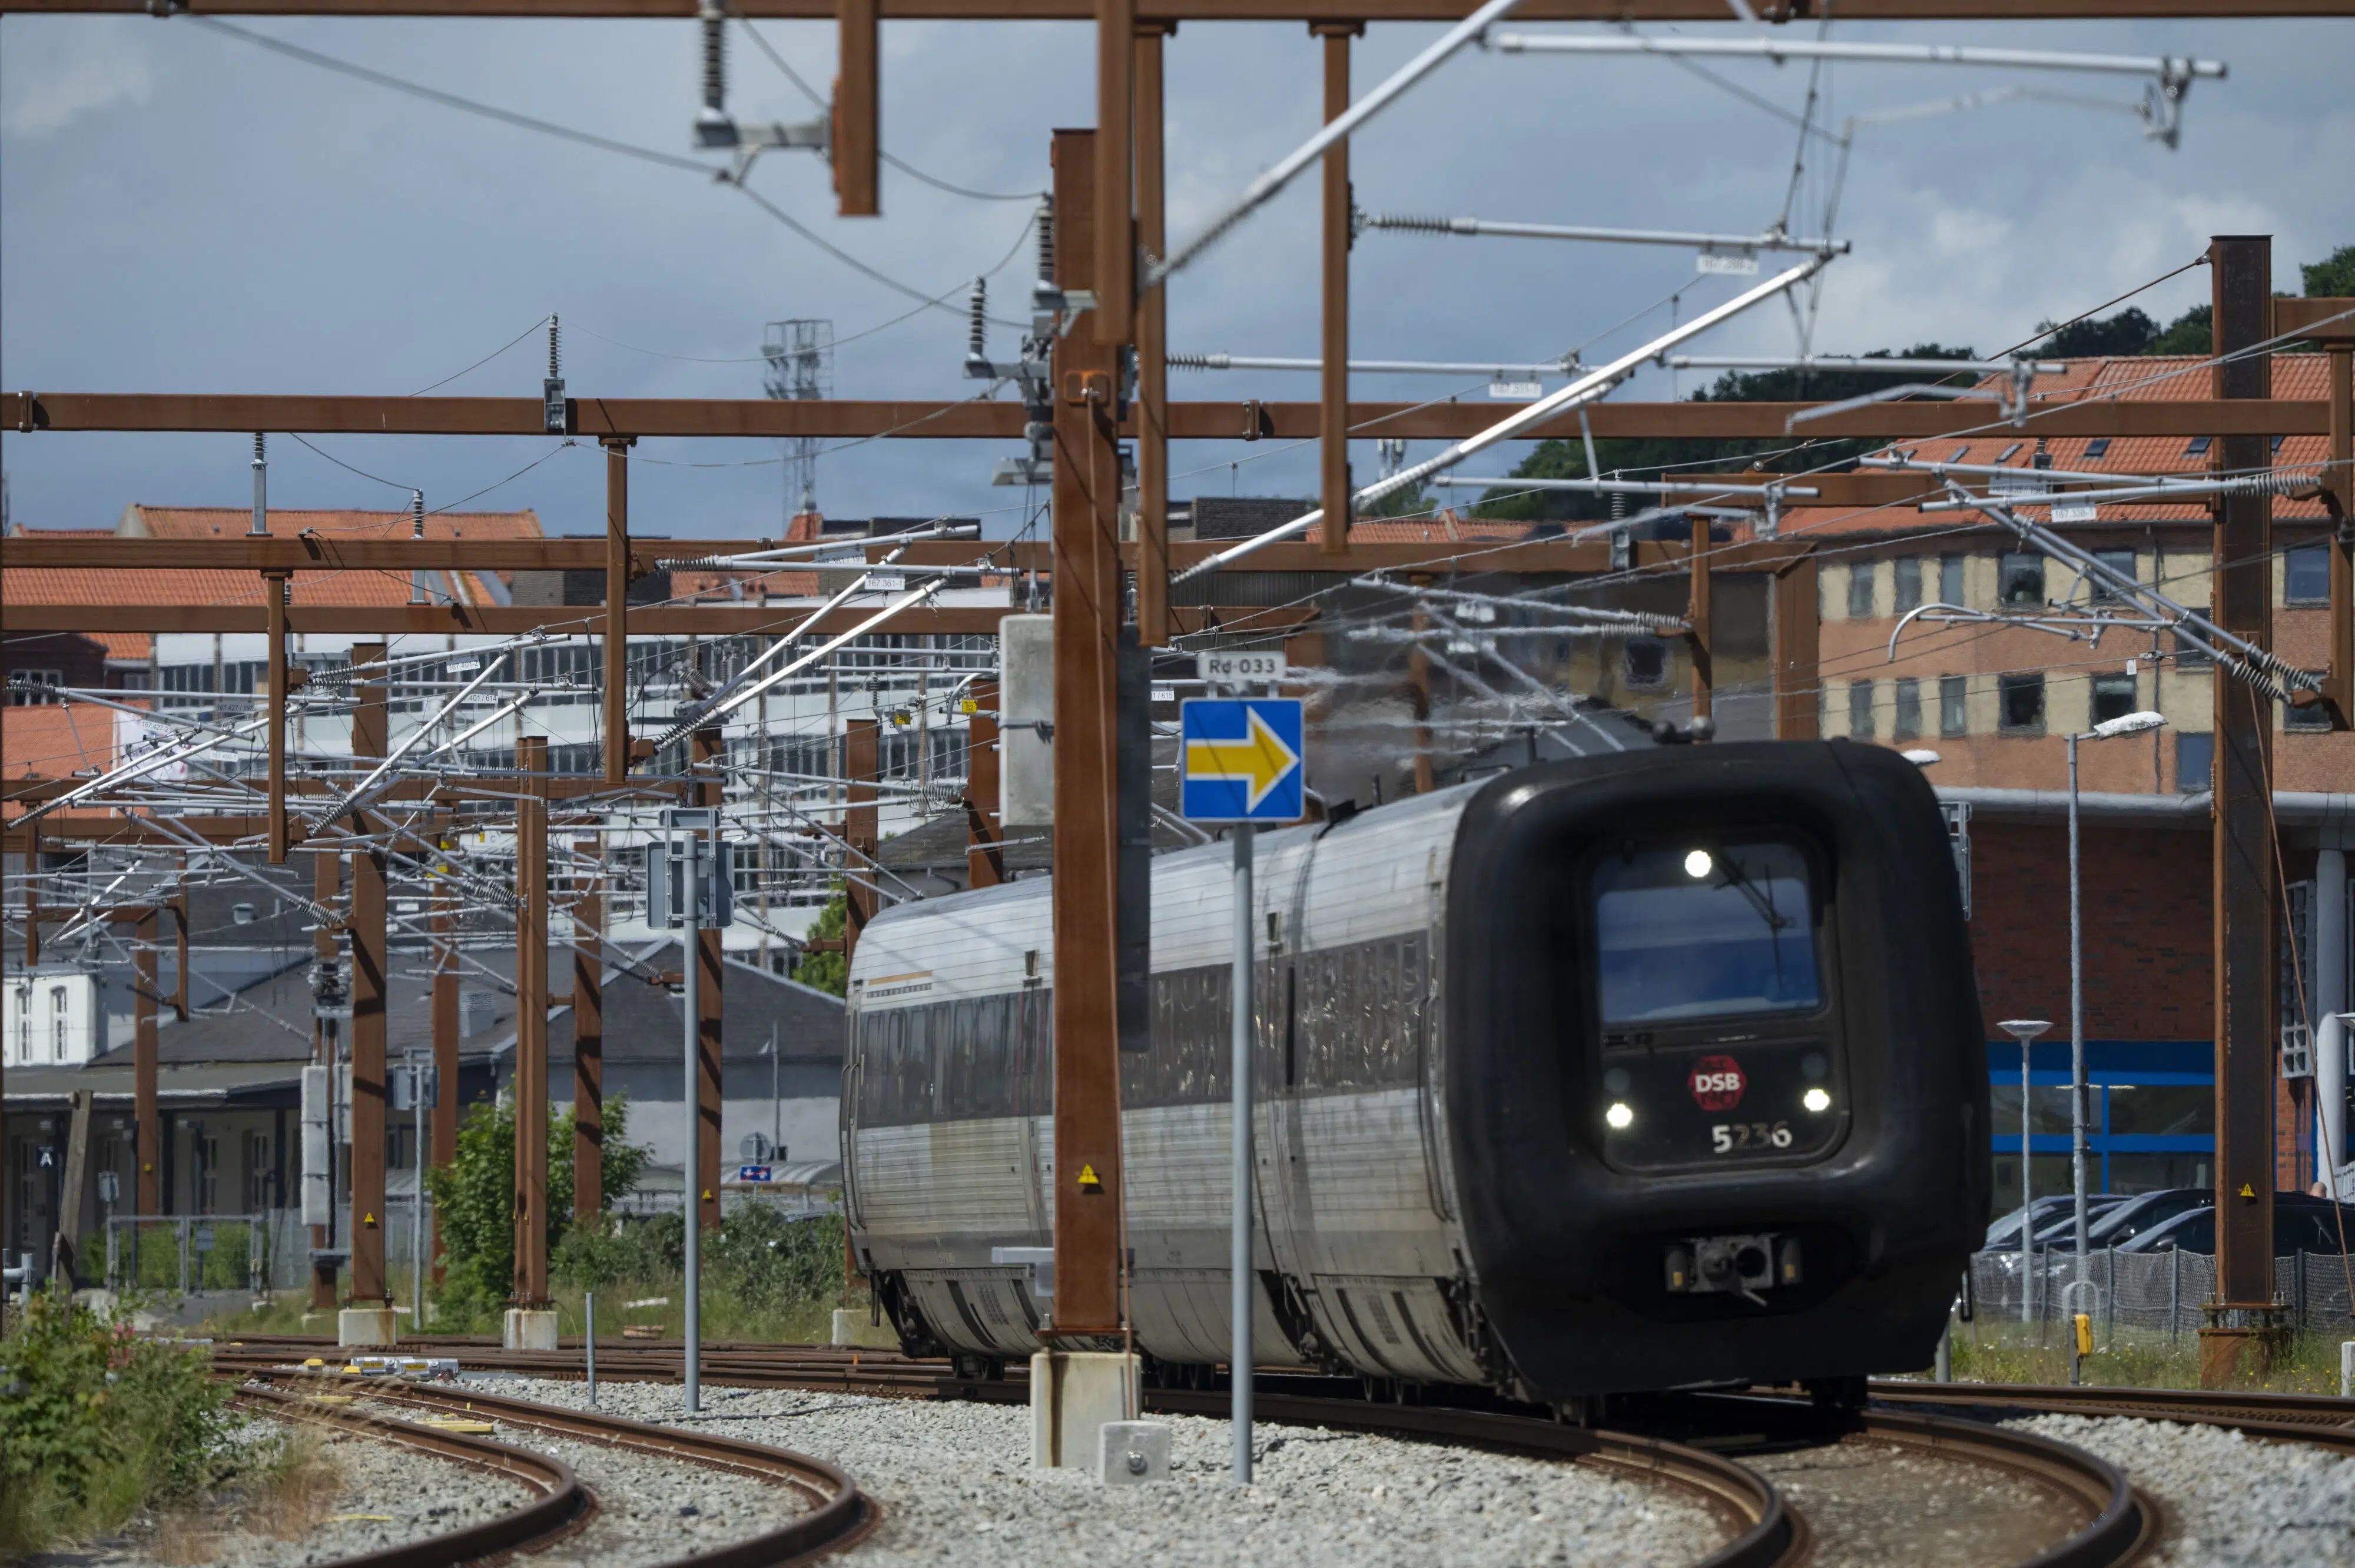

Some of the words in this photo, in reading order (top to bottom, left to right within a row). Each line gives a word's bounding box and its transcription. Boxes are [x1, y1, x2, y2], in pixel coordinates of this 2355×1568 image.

[1696, 1072, 1740, 1094] DSB
[1711, 1121, 1793, 1154] 5236
[39, 1152, 52, 1167] A
